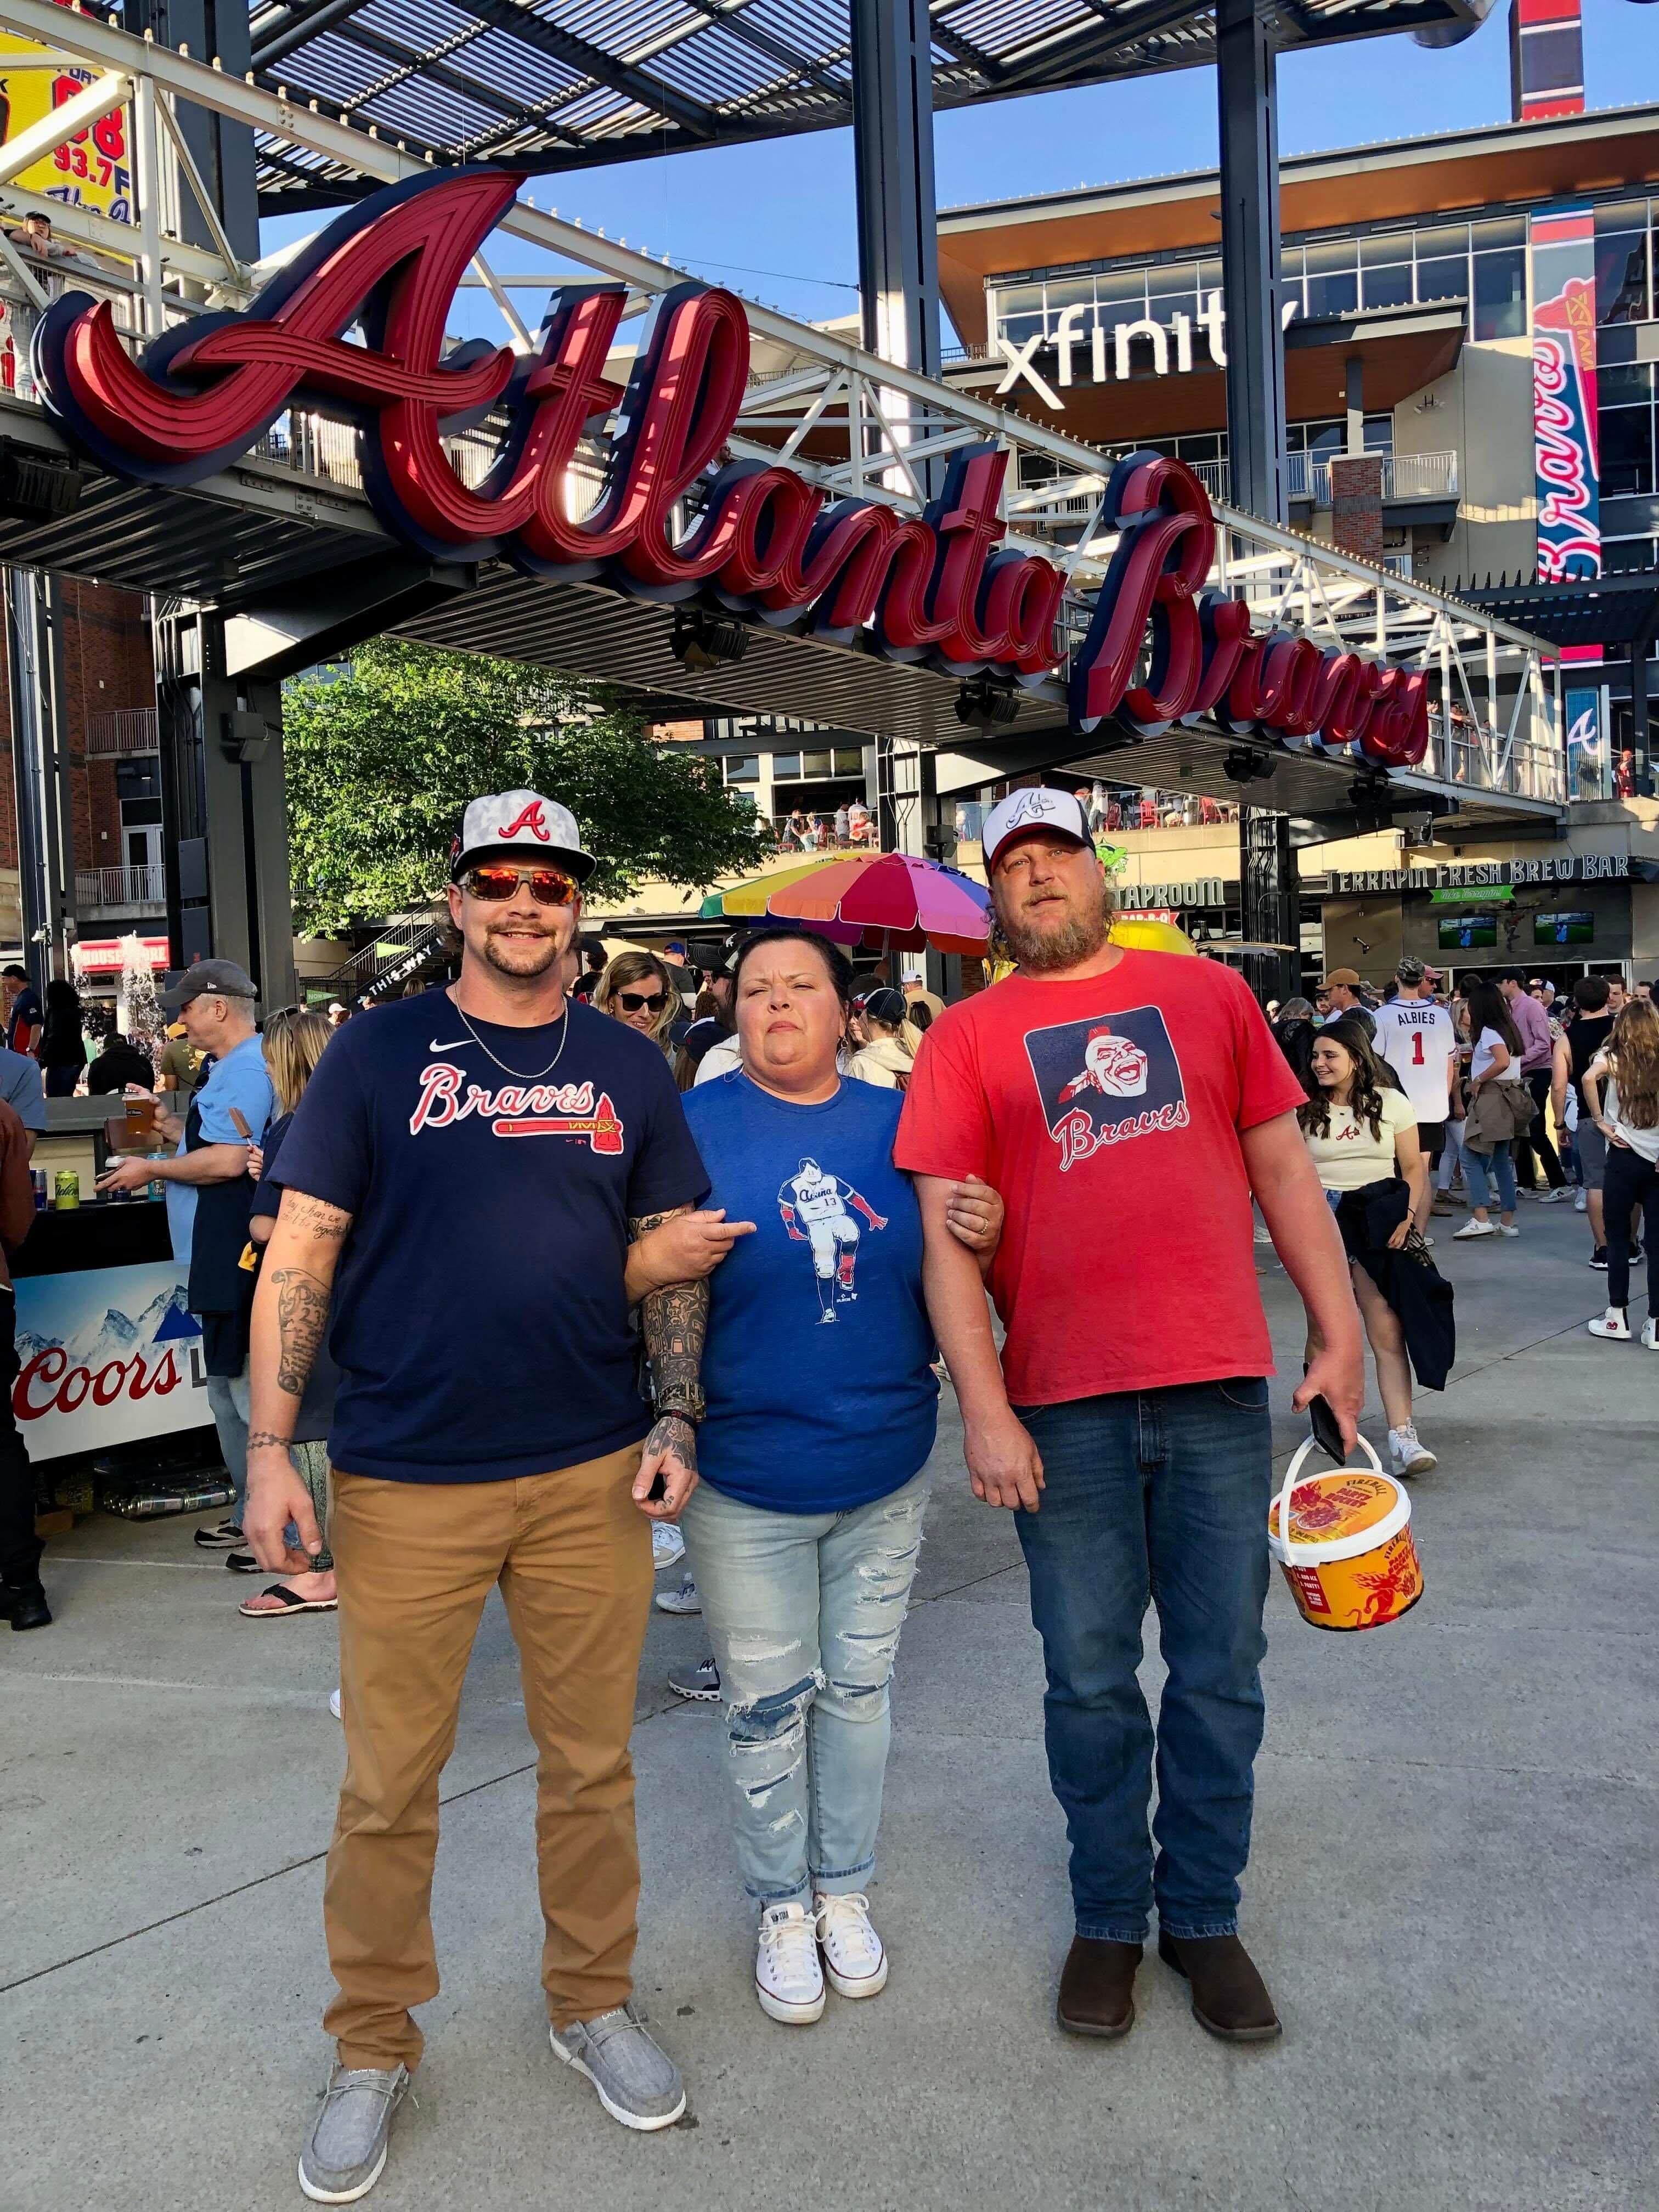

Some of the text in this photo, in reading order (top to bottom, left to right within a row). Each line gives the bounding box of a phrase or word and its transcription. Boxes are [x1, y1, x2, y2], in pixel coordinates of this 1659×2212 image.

[995, 290, 1299, 410] xfinit
[33, 166, 1430, 772] Atlanta Braves
[498, 799, 550, 842] A
[1111, 877, 1226, 909] TAPROOM
[1325, 854, 1629, 894] TERRAPIN FRESH BREW BAR
[1397, 1012, 1435, 1026] ALBIES
[1412, 1031, 1424, 1065] 1
[410, 1063, 594, 1135] Braves
[1051, 1099, 1189, 1172] Braves
[13, 1347, 182, 1421] Coors
